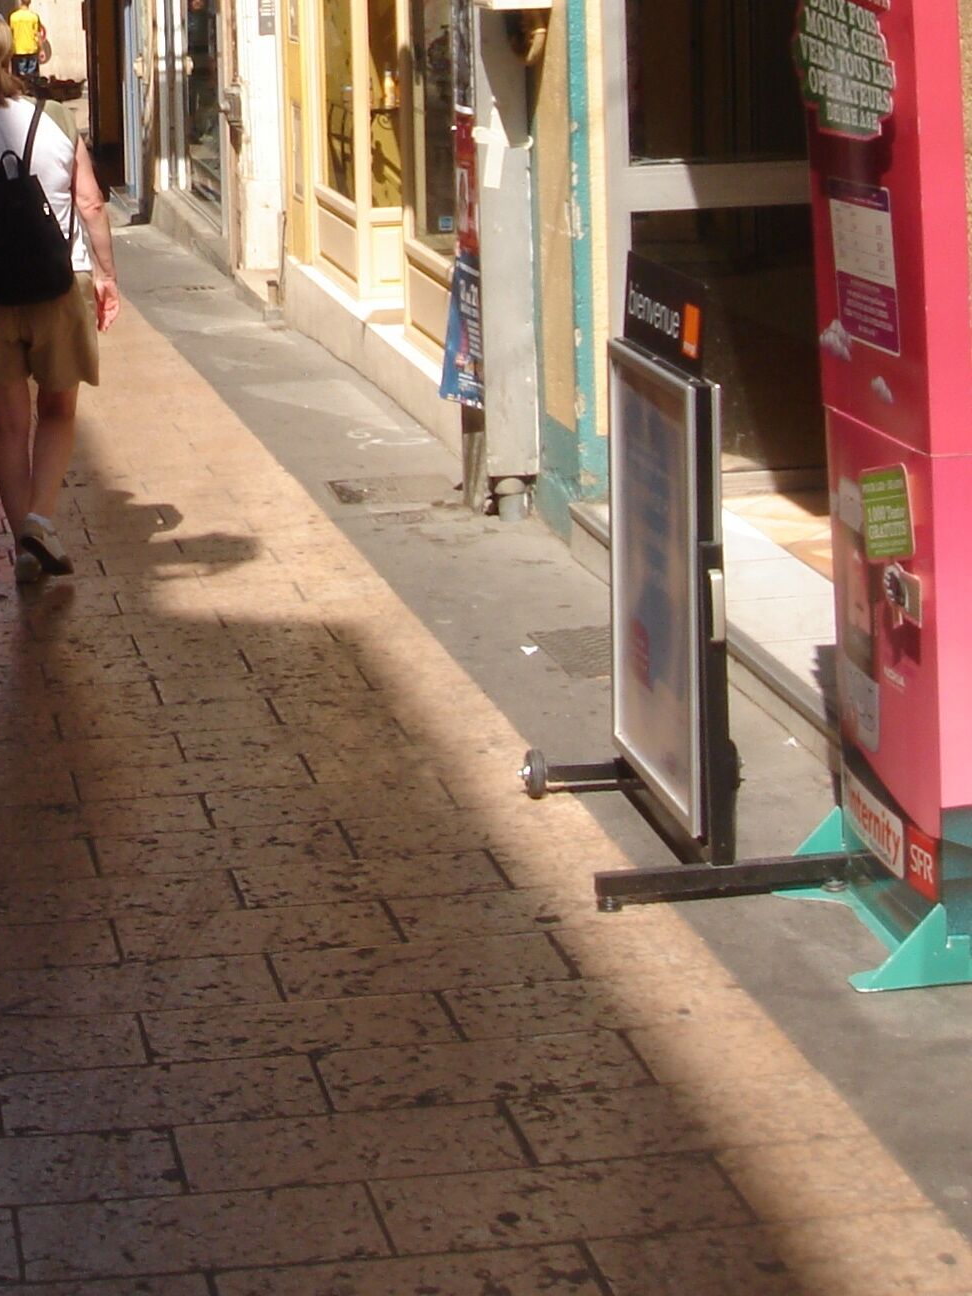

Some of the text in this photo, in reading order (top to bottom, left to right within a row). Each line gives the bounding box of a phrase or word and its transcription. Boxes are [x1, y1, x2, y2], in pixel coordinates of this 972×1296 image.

[804, 6, 887, 62] MOINS CHER
[847, 0, 878, 35] FOIS
[799, 33, 893, 90] VERS TOUS LES
[808, 66, 892, 114] OPERATEURS
[628, 280, 681, 340] bienvenue
[909, 844, 934, 885] SFR
